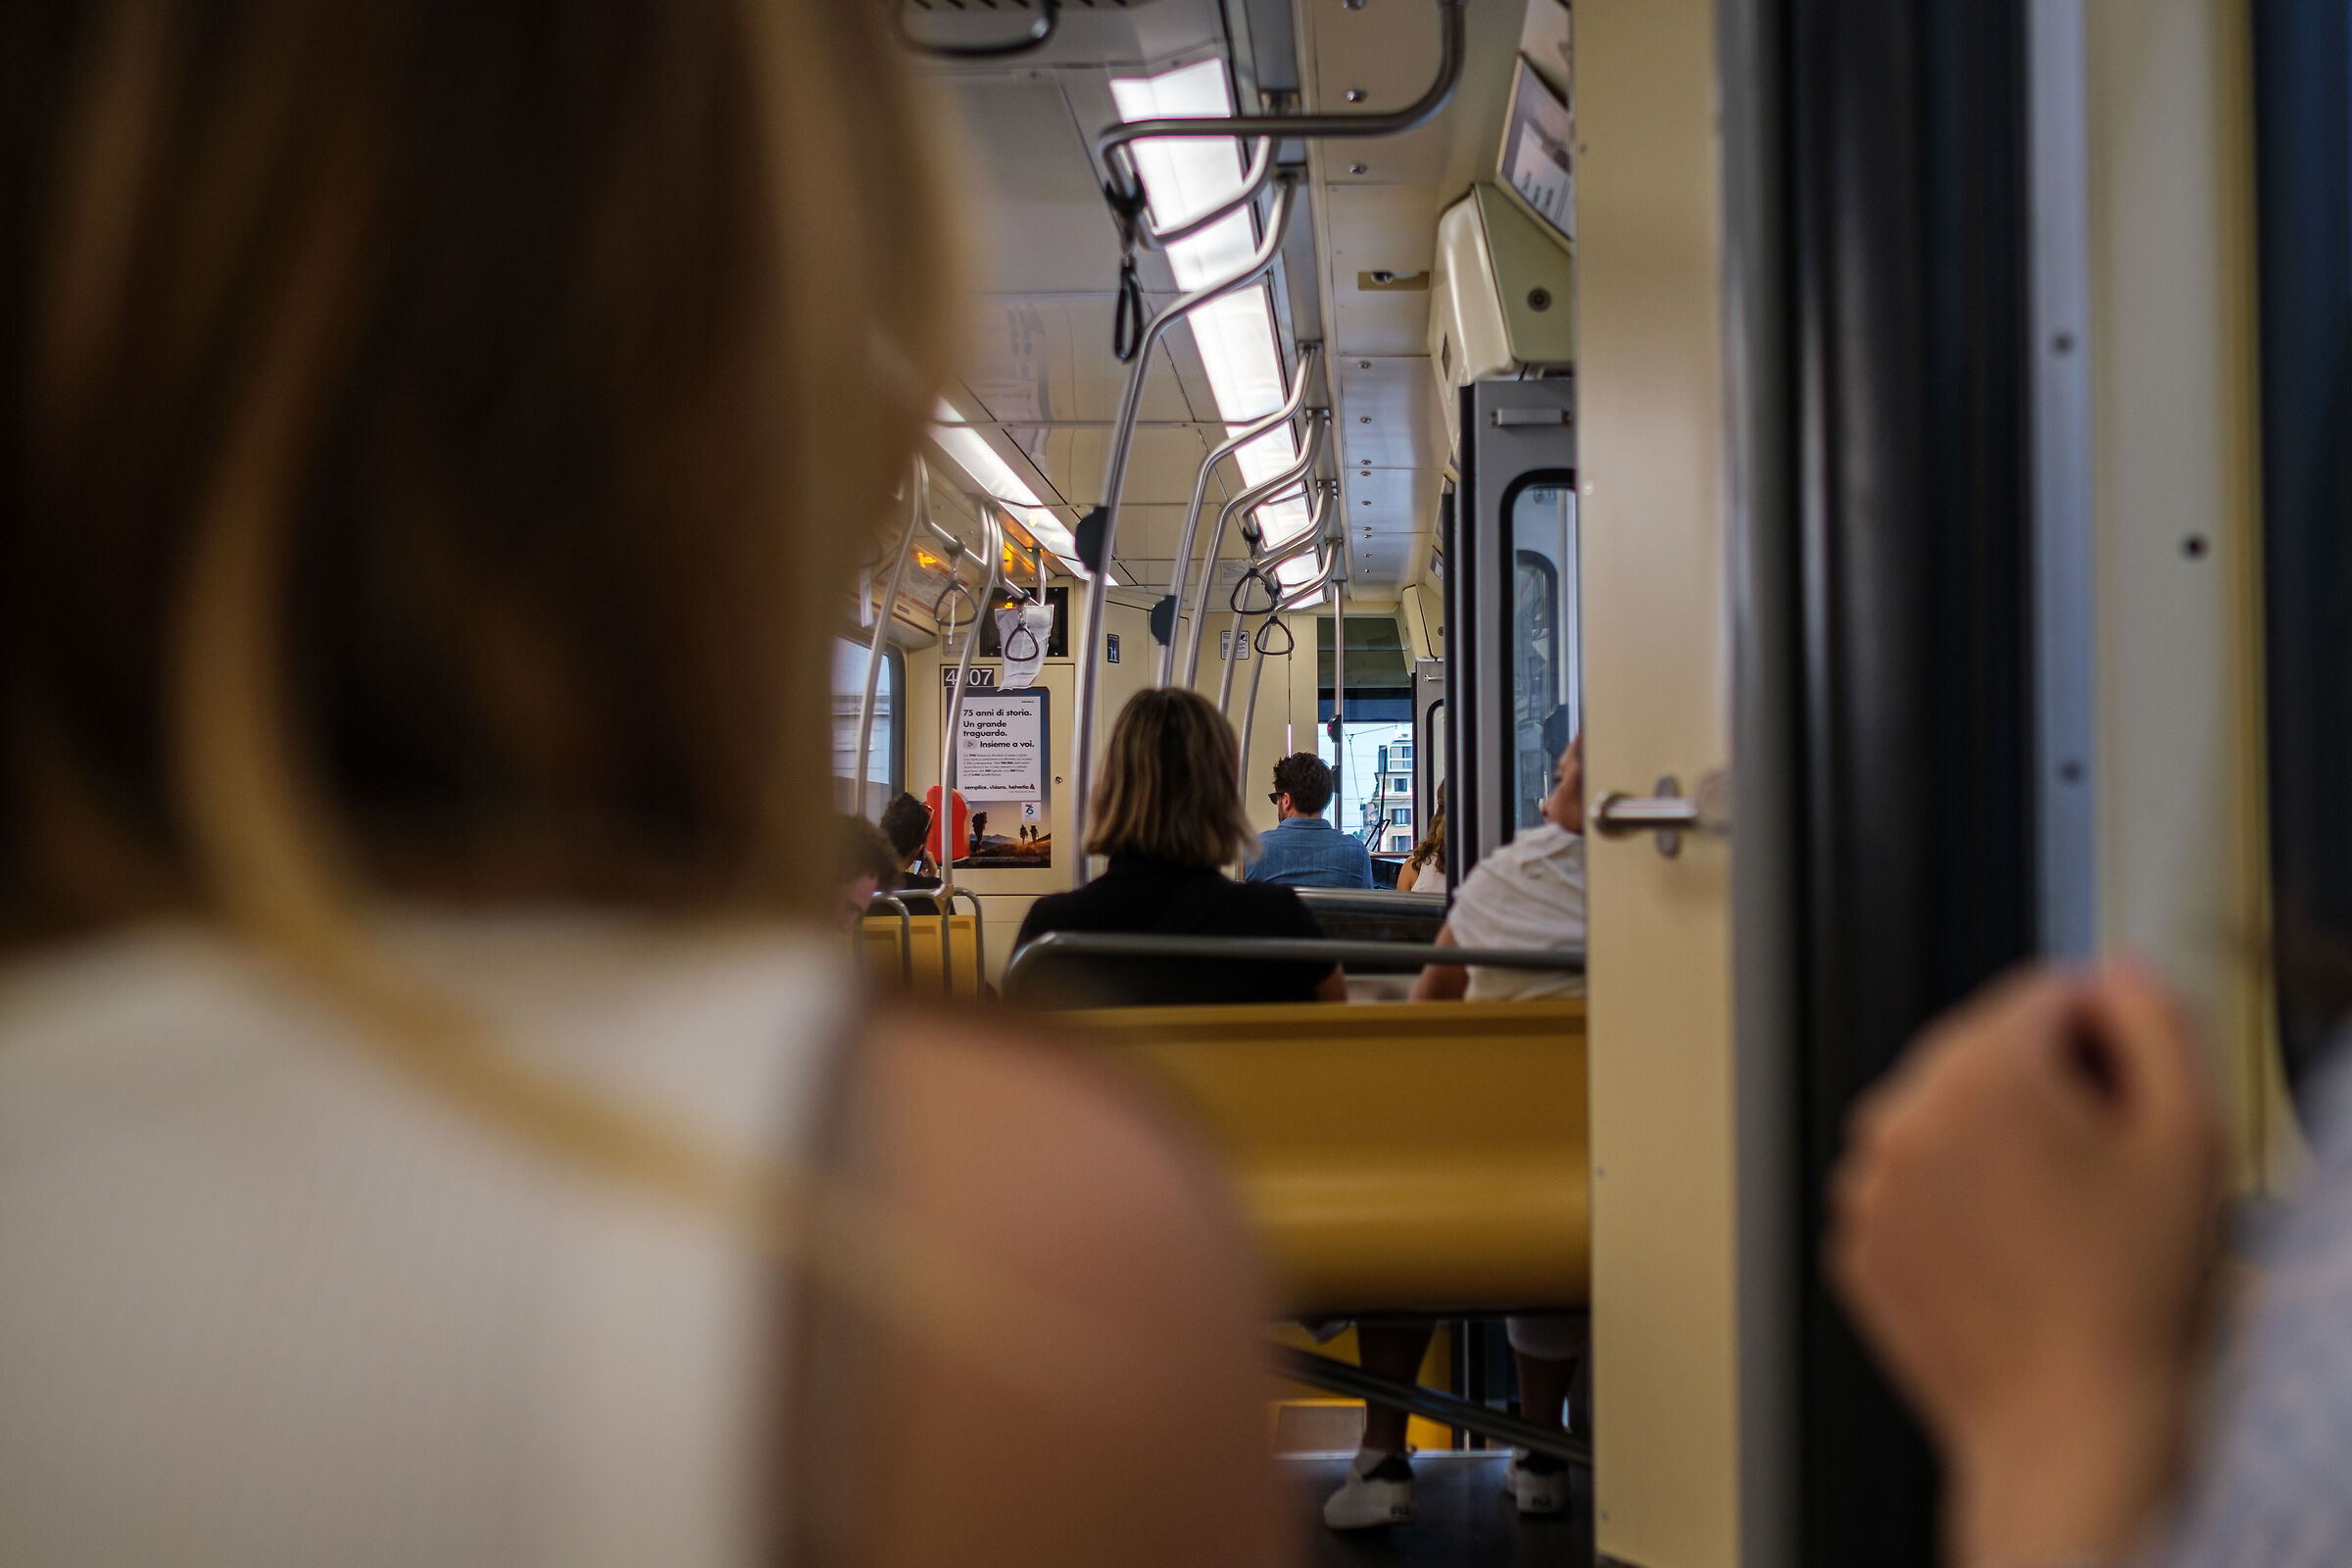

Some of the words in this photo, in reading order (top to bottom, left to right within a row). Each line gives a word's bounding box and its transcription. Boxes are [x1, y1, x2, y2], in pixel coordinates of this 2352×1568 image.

[945, 668, 993, 686] 407
[977, 719, 1006, 729] grande
[963, 729, 1007, 739] traguardo.
[1019, 739, 1035, 748] voi.
